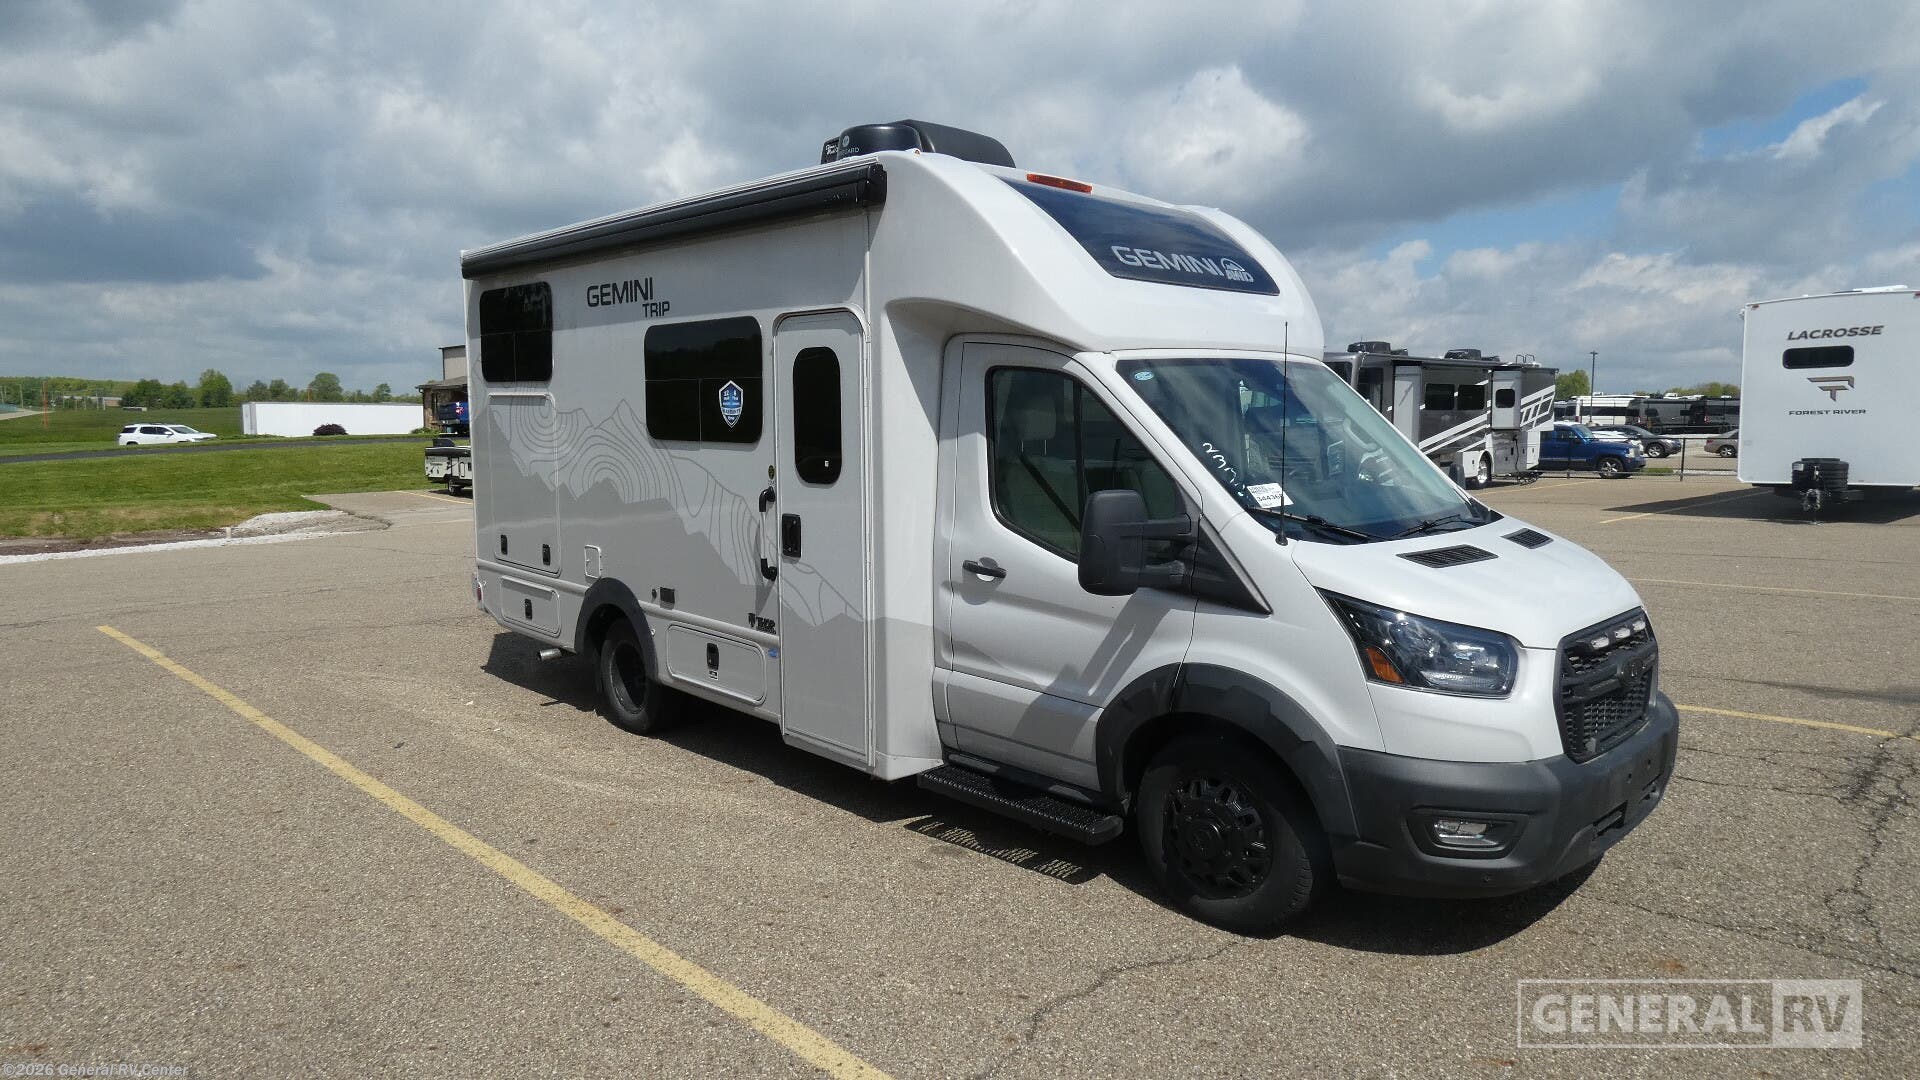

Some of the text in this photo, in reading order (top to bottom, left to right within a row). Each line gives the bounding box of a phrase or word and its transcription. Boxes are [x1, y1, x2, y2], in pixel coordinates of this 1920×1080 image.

[1111, 246, 1224, 276] GEMINI
[586, 277, 653, 307] GEMINI
[642, 301, 670, 317] TRIP
[1787, 325, 1885, 340] LACROSSE
